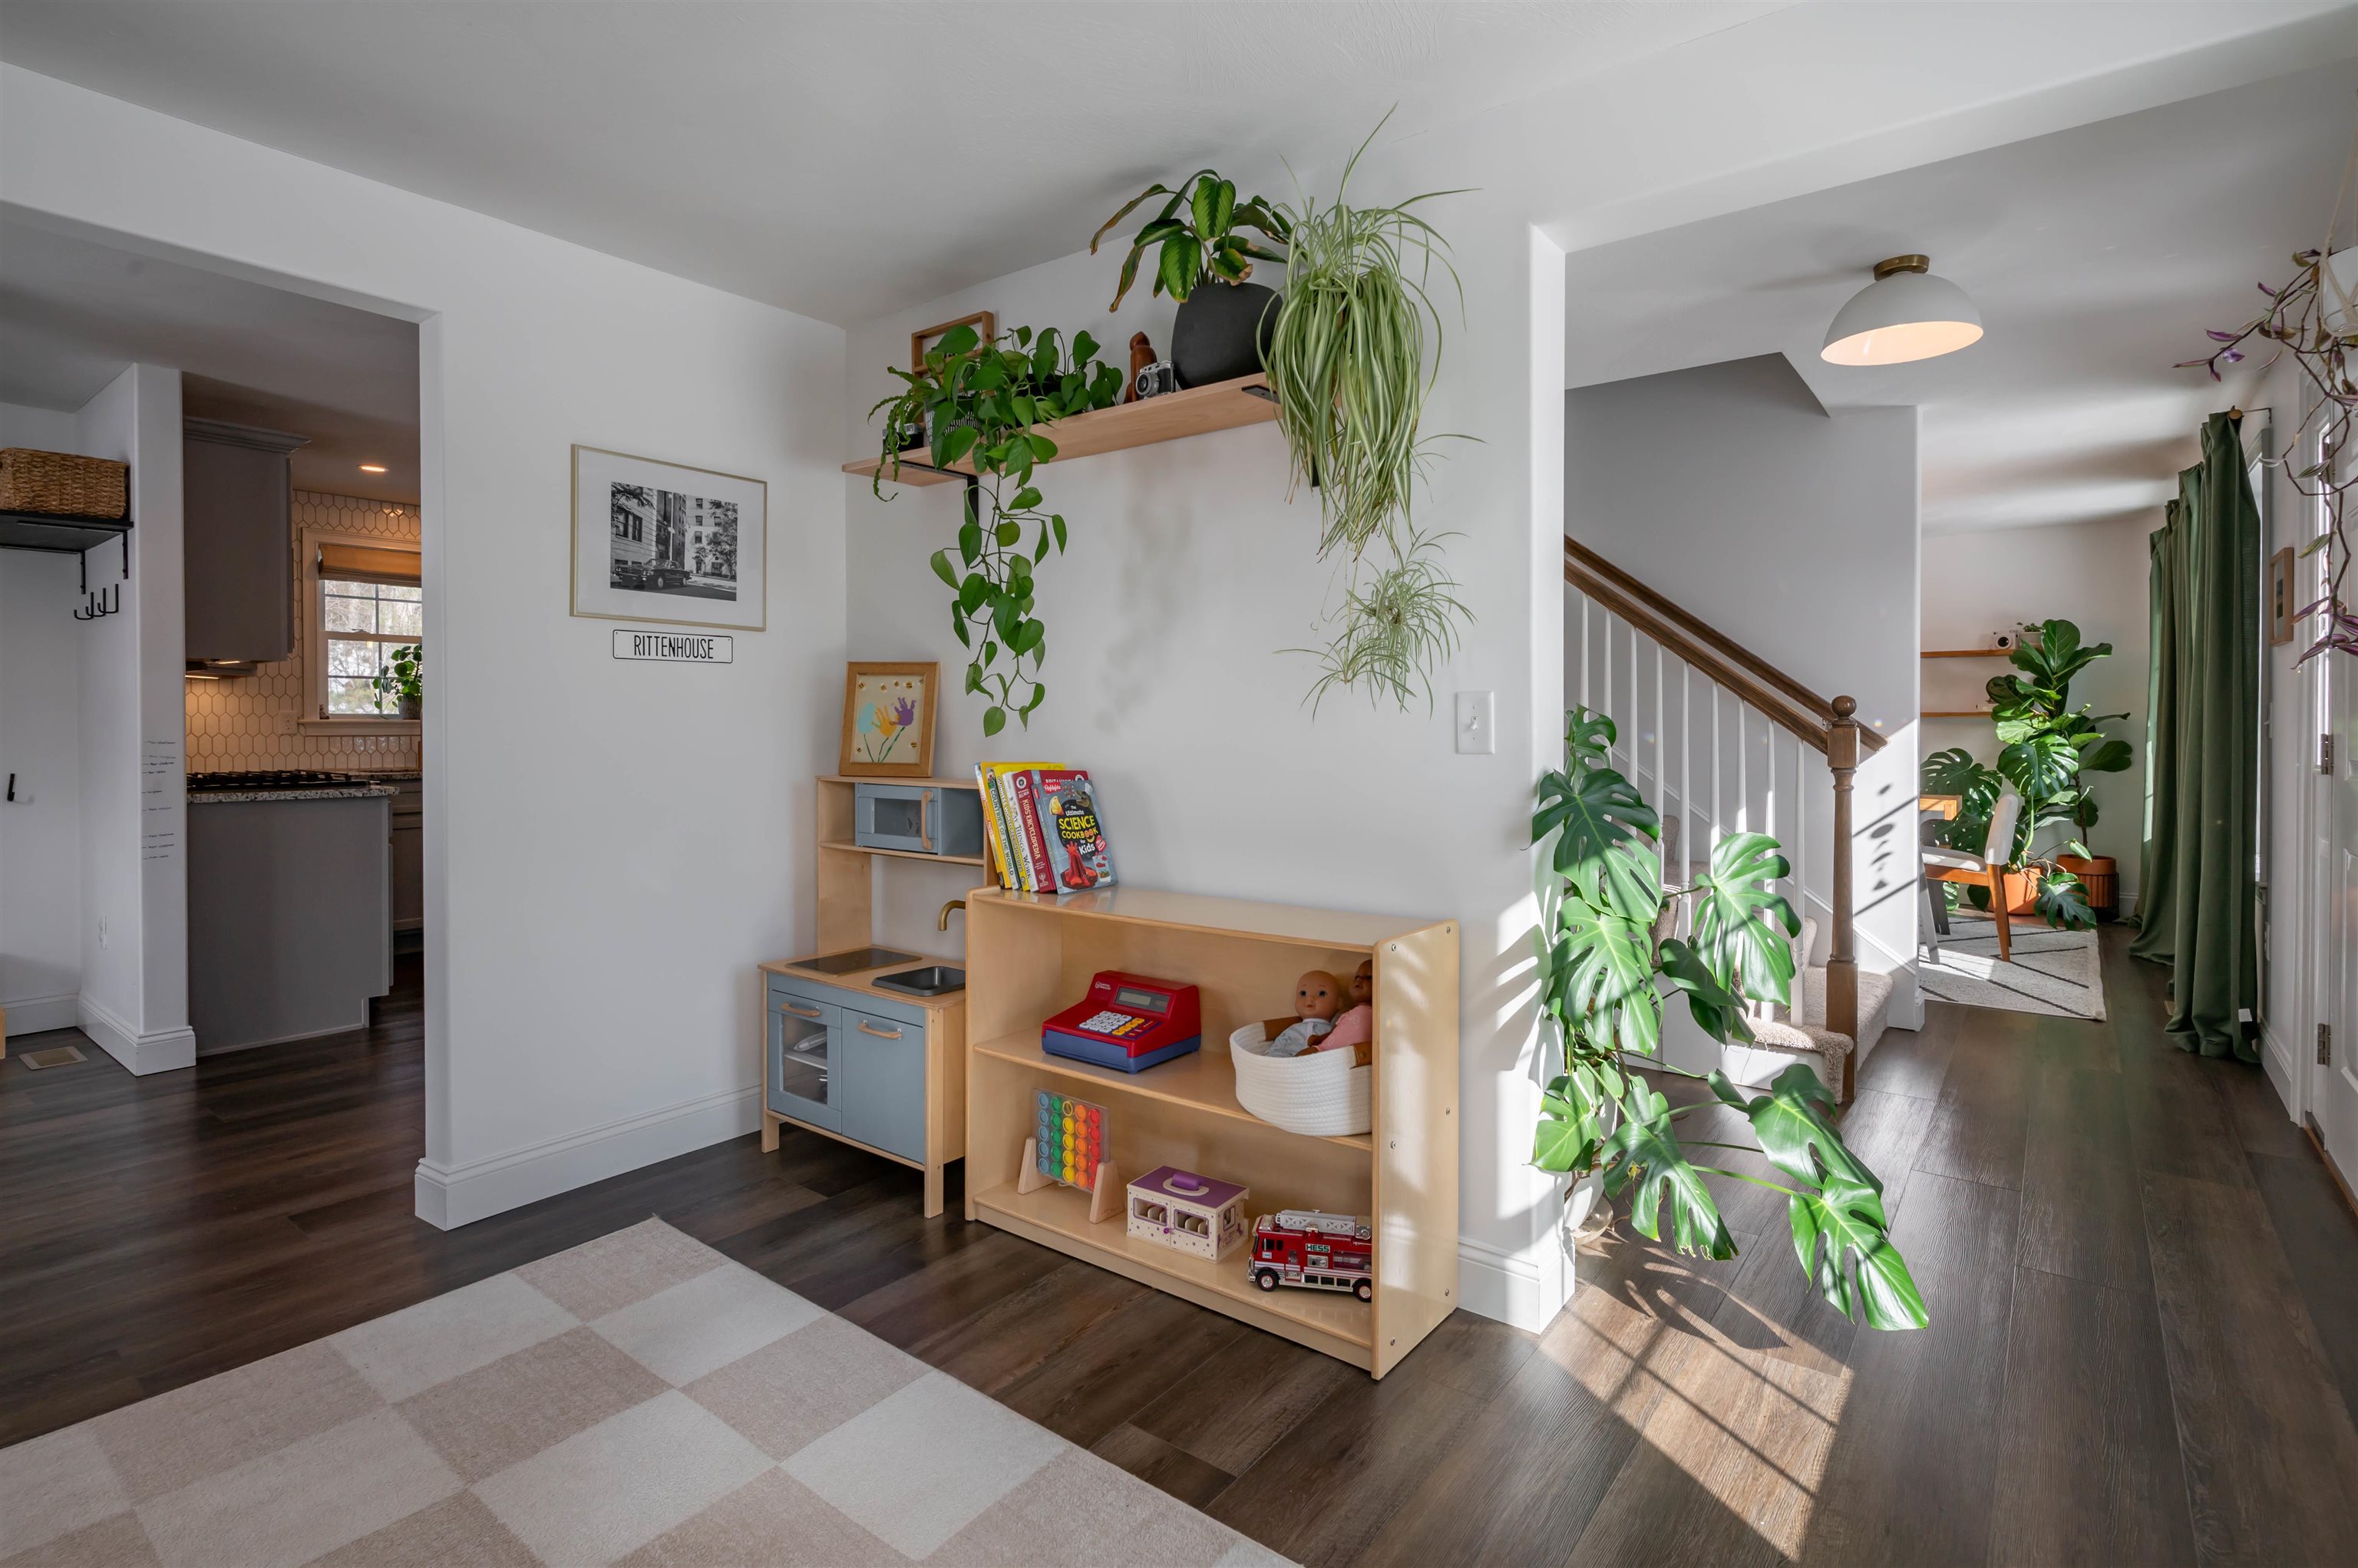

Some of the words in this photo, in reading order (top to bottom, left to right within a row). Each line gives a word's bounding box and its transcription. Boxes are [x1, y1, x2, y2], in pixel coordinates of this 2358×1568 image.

[634, 635, 714, 659] RITTENHOUSE
[997, 777, 1007, 805] GUINNESS
[991, 789, 1002, 827] COUNTRIES
[1006, 851, 1014, 876] WORLD
[1058, 815, 1095, 830] SCIENCE
[1062, 827, 1098, 840] COOKBOOK
[1025, 815, 1041, 860] ENCYCLOPEDIA
[1078, 843, 1095, 855] Kids
[1016, 824, 1025, 852] THINGS
[1023, 854, 1032, 879] WORK
[1306, 1244, 1329, 1253] HESS
